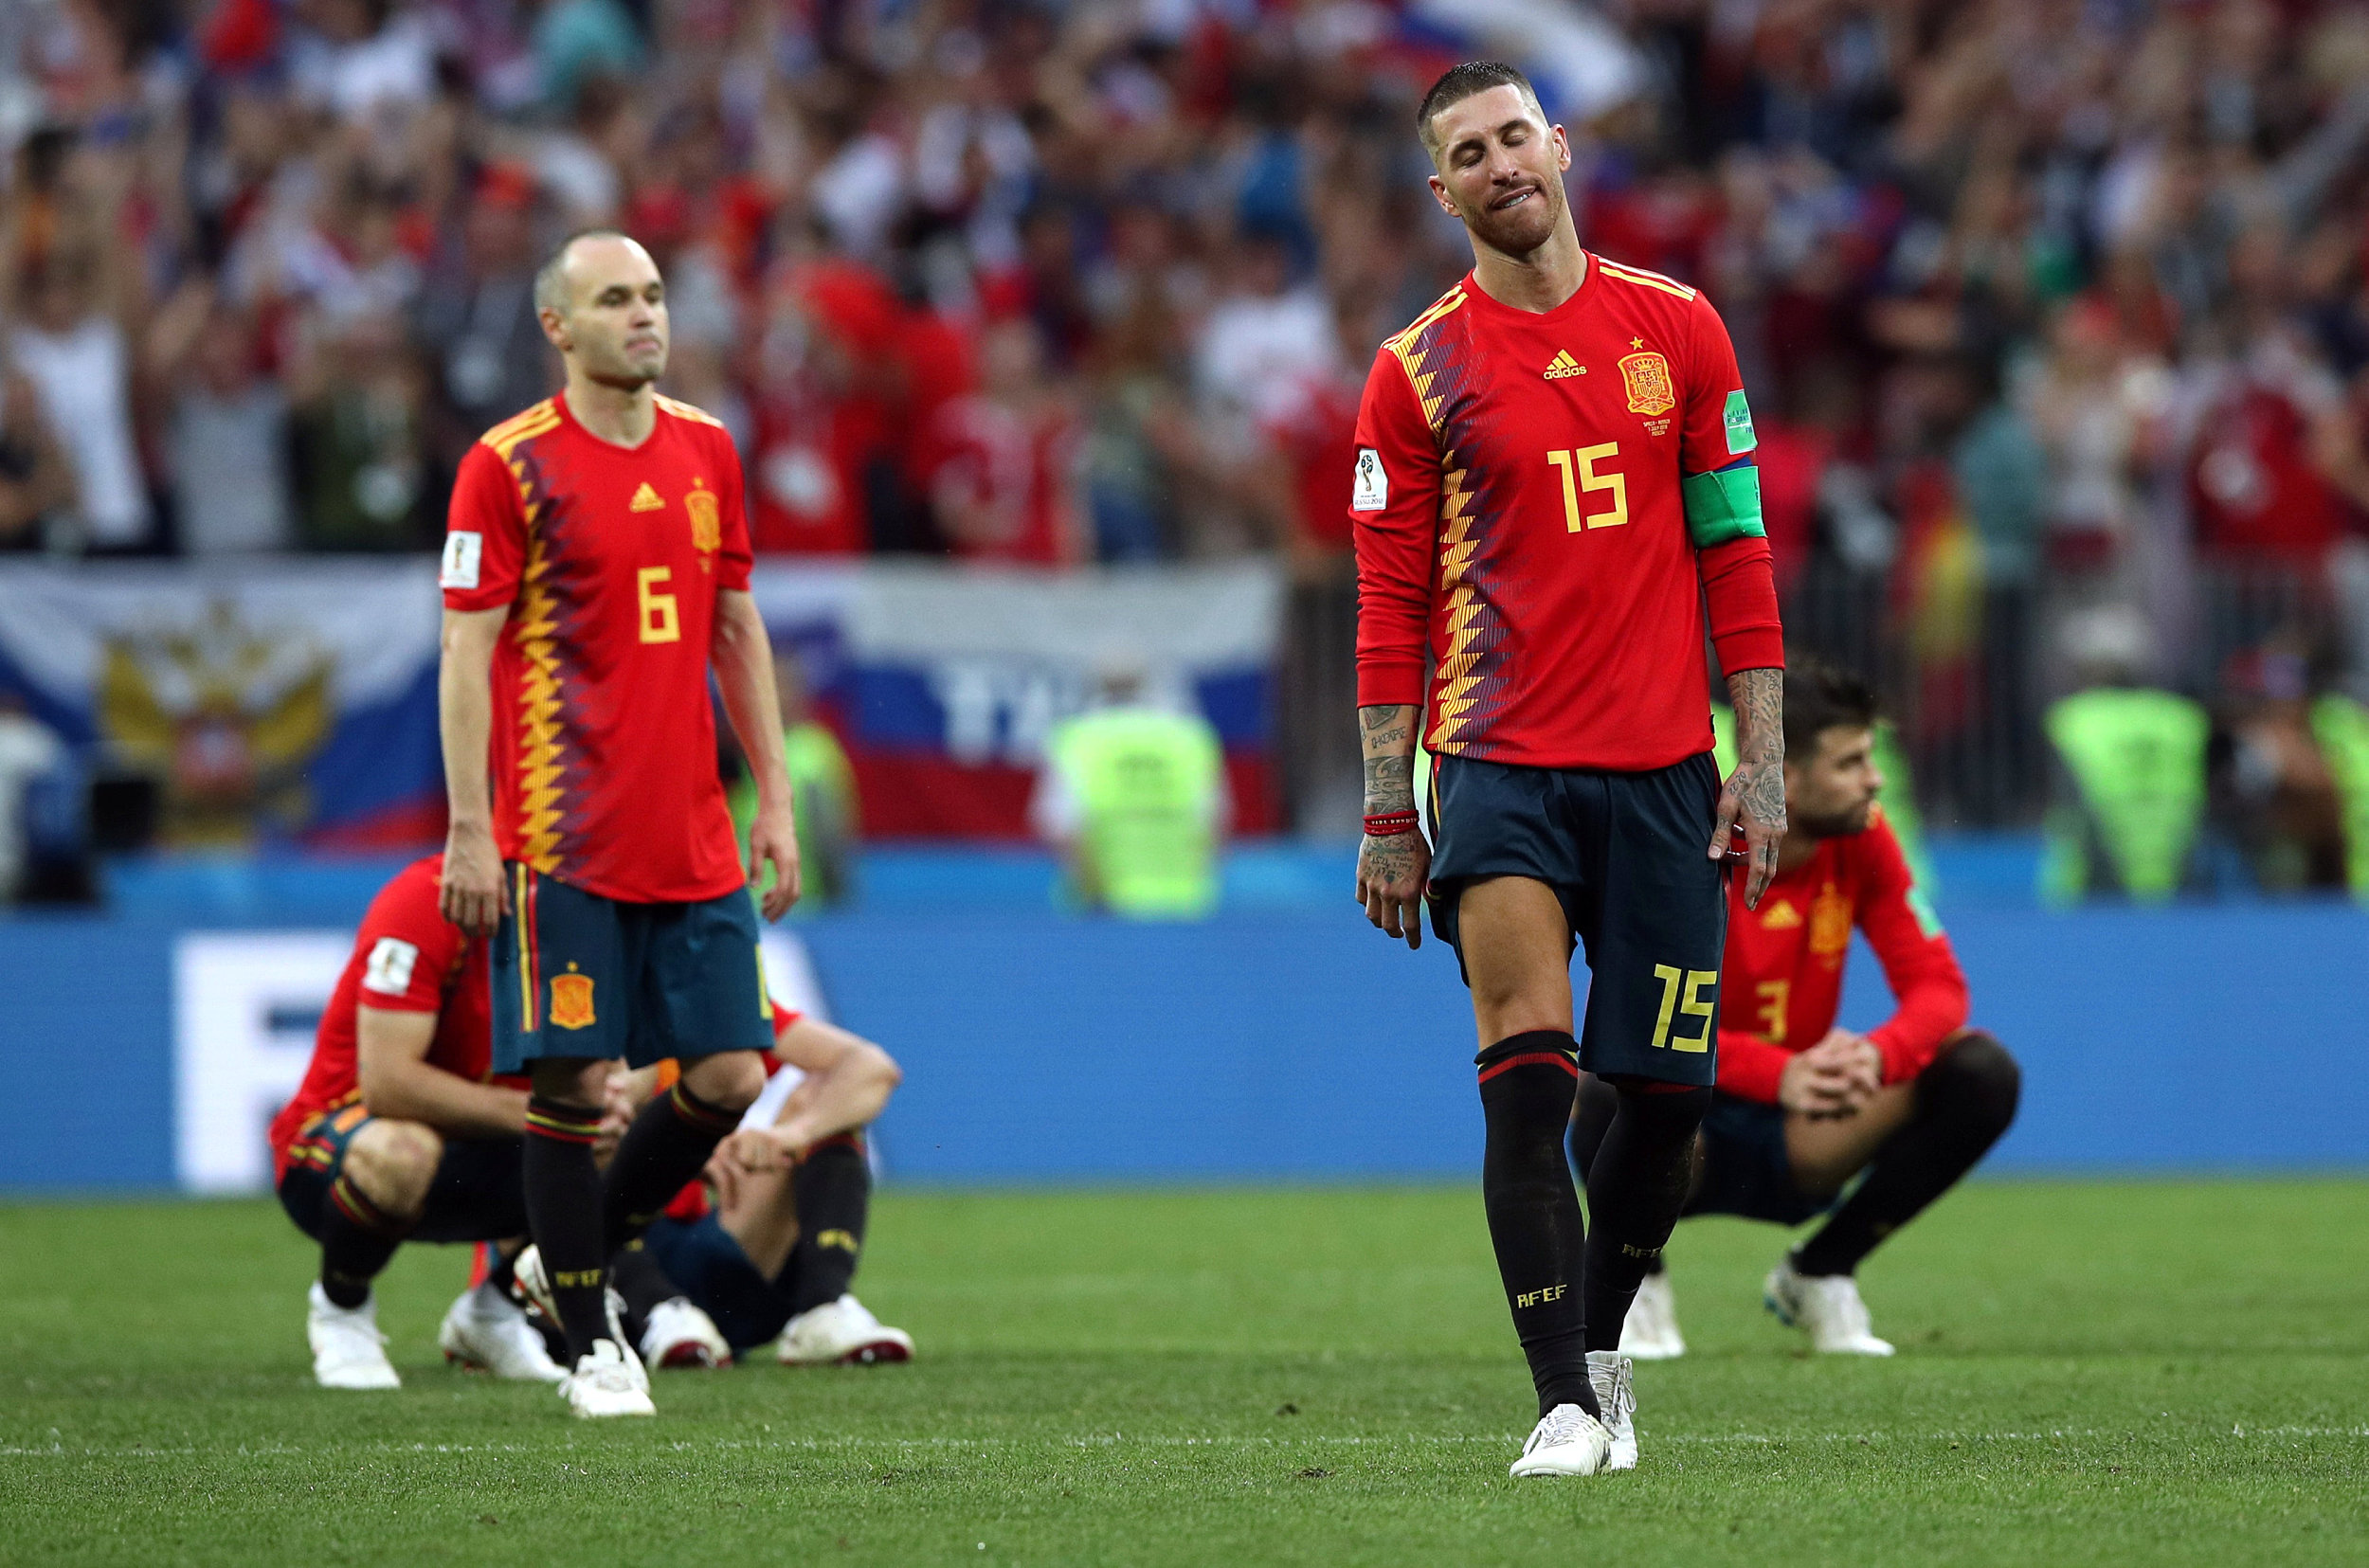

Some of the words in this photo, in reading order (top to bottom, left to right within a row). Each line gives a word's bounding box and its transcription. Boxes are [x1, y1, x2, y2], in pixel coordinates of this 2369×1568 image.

[1543, 365, 1587, 380] adidas
[1547, 441, 1628, 533] 15
[637, 566, 680, 644] 6
[1652, 964, 1717, 1053] 15
[1756, 979, 1790, 1044] 3
[1517, 1284, 1567, 1308] RFEF
